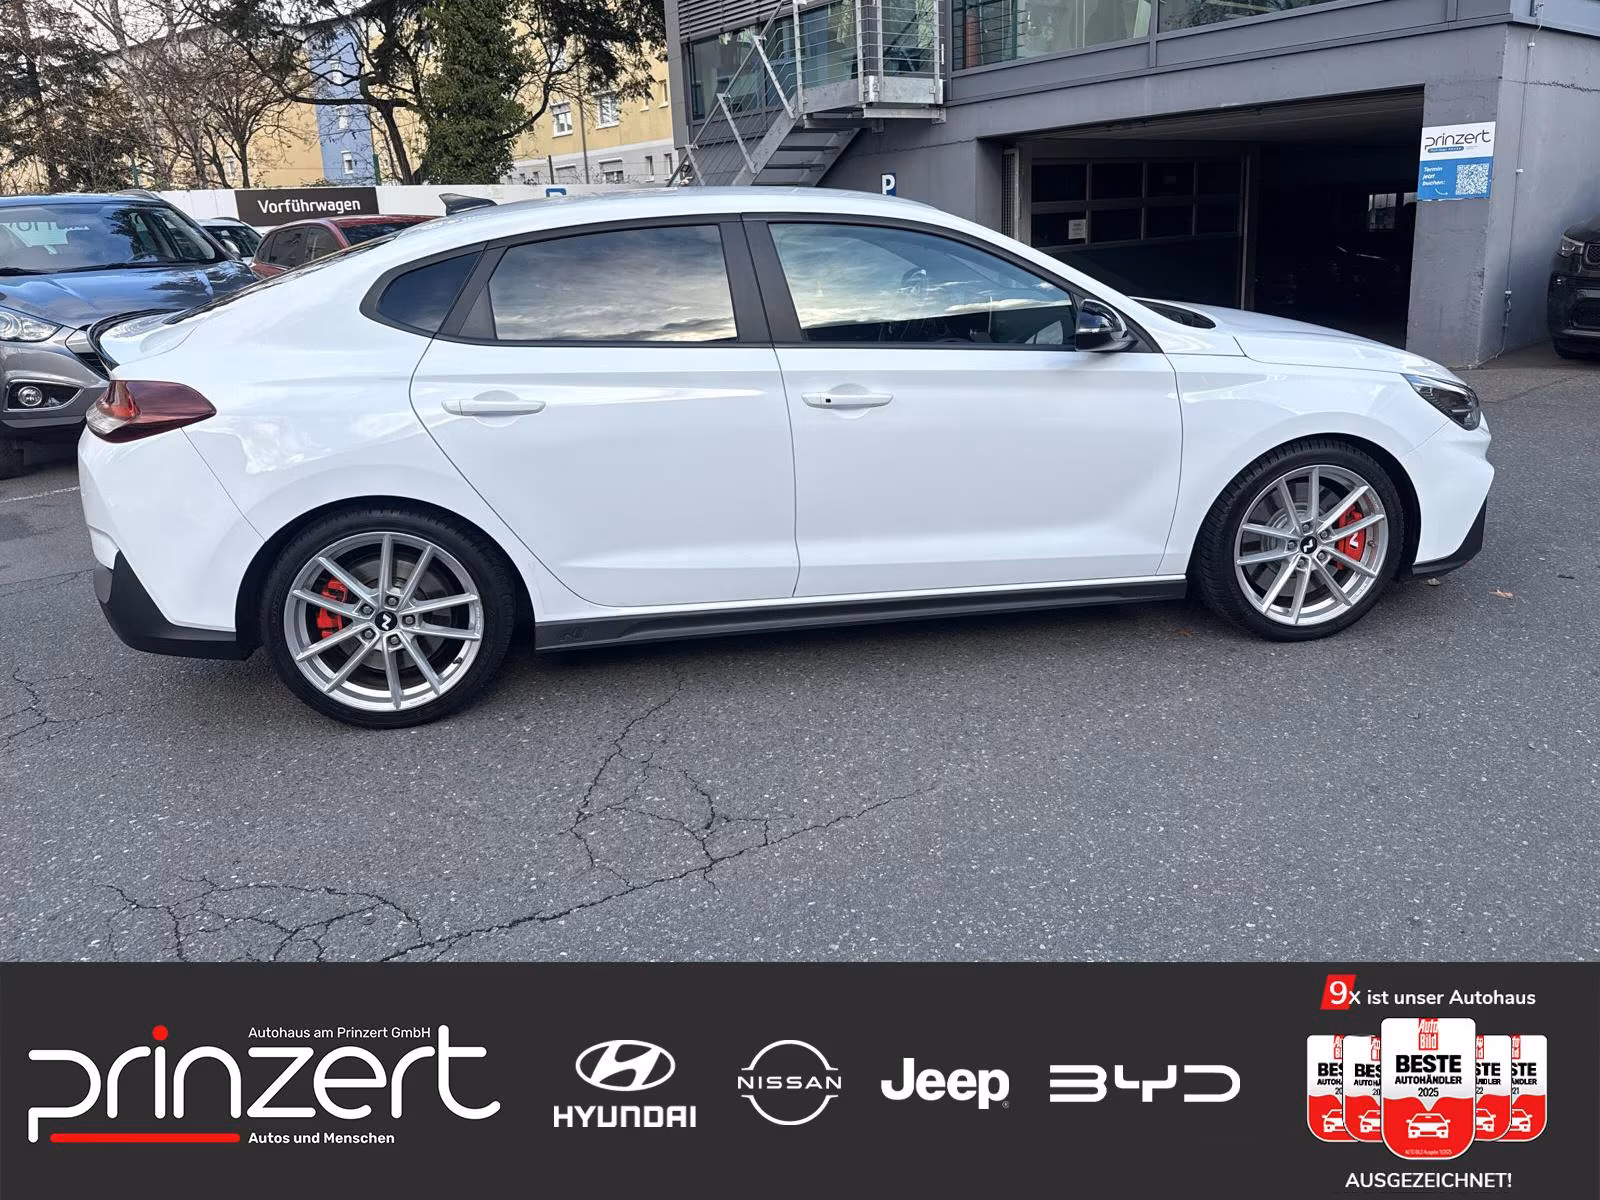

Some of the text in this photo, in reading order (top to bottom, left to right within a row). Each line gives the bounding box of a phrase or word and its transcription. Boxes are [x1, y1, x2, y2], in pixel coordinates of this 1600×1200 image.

[1425, 129, 1491, 151] prinzert
[881, 174, 896, 195] P
[257, 199, 361, 215] Vorführwagen
